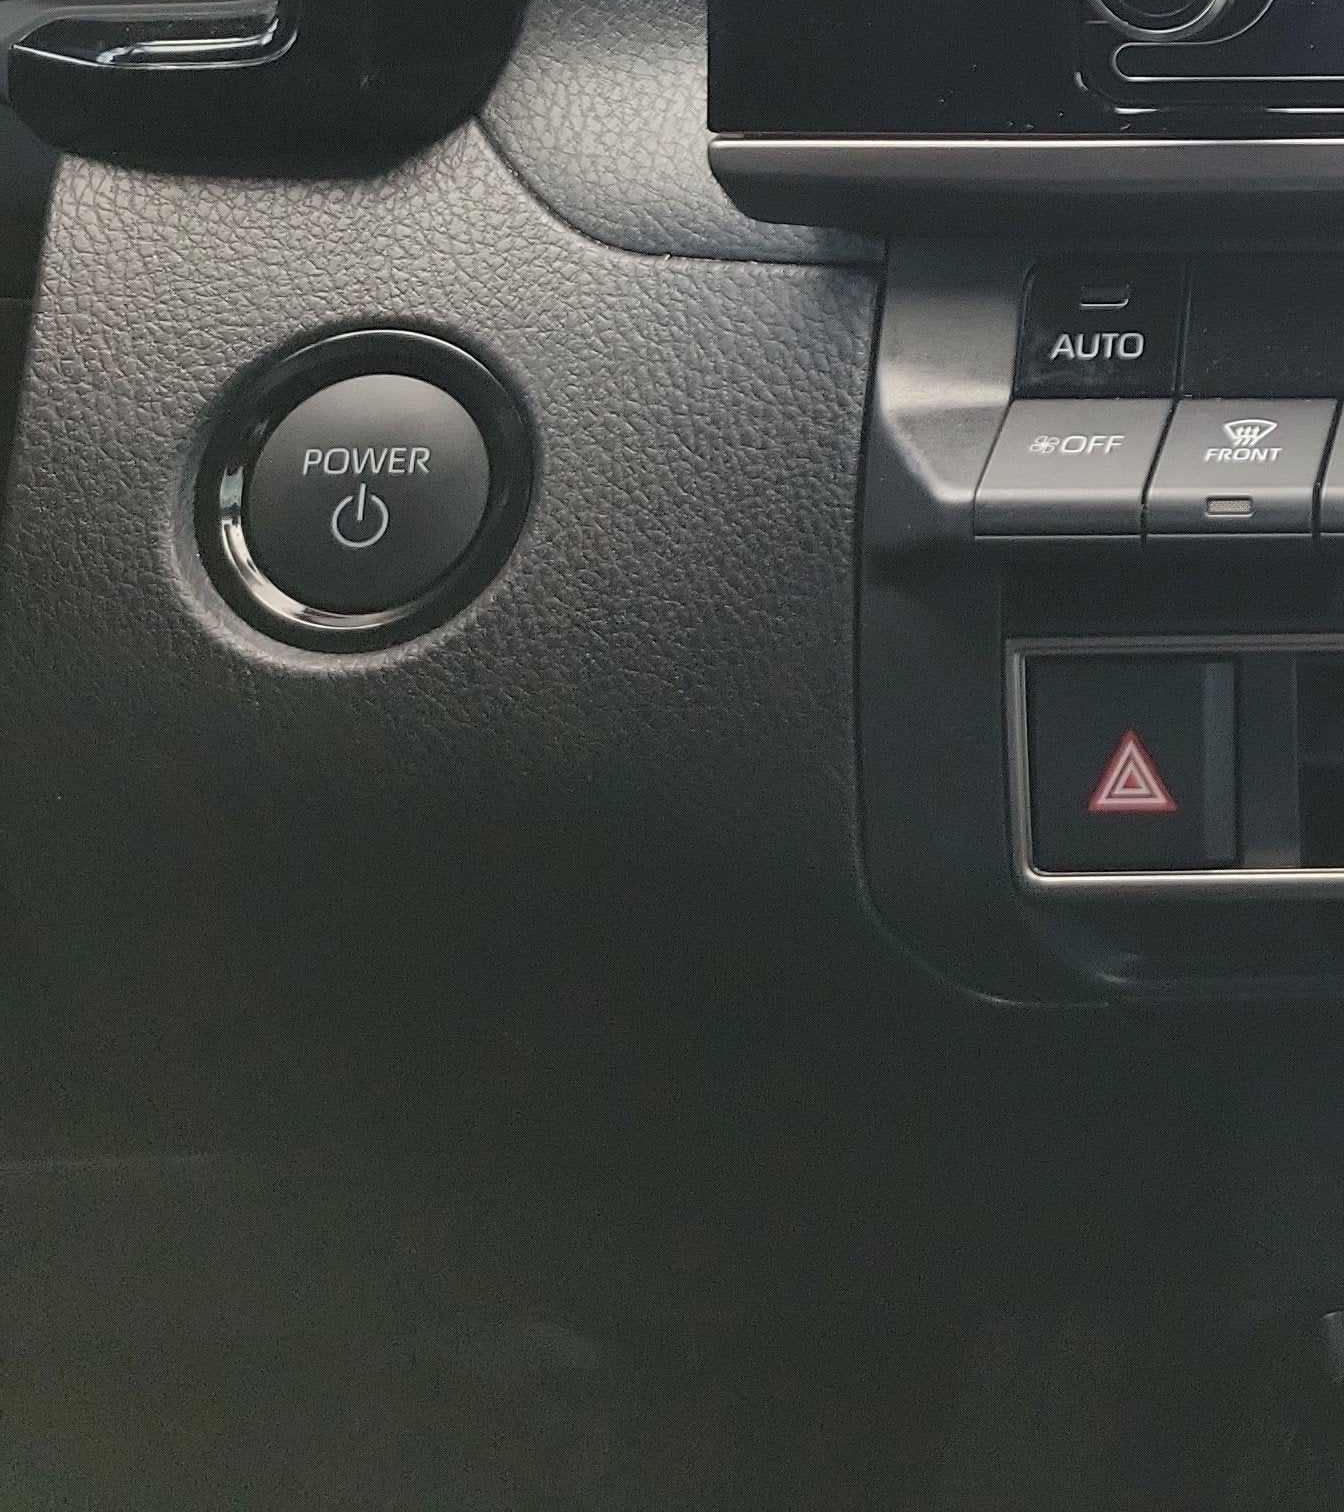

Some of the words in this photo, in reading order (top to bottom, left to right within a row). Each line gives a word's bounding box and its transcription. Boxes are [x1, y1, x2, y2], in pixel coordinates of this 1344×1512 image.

[1049, 332, 1146, 360] AUTO
[1060, 434, 1126, 455] OFF
[1205, 447, 1283, 462] FRONT
[302, 446, 431, 476] POWER
